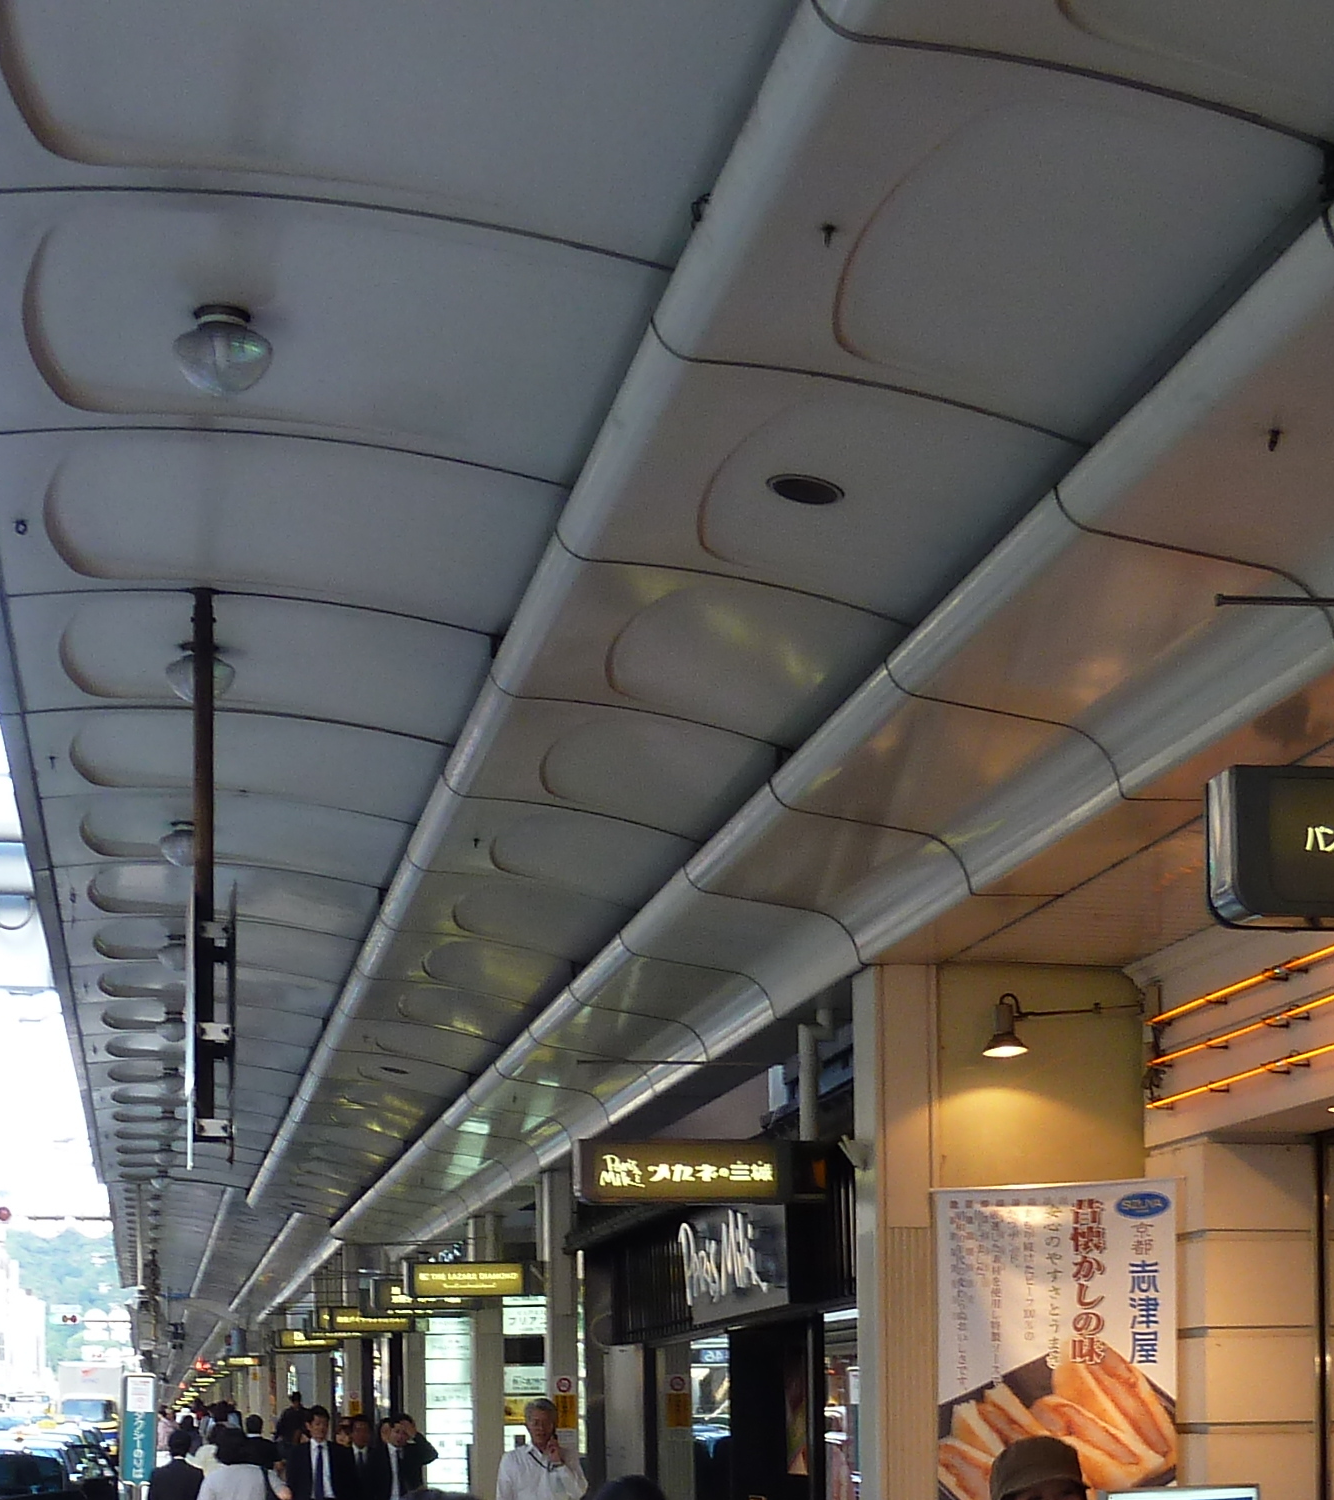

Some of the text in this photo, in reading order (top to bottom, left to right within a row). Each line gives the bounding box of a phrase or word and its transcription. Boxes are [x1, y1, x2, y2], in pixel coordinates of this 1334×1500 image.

[1070, 1198, 1107, 1366] 昔懐かしの味
[1130, 1222, 1155, 1255] 京都
[1128, 1260, 1160, 1365] 志津屋
